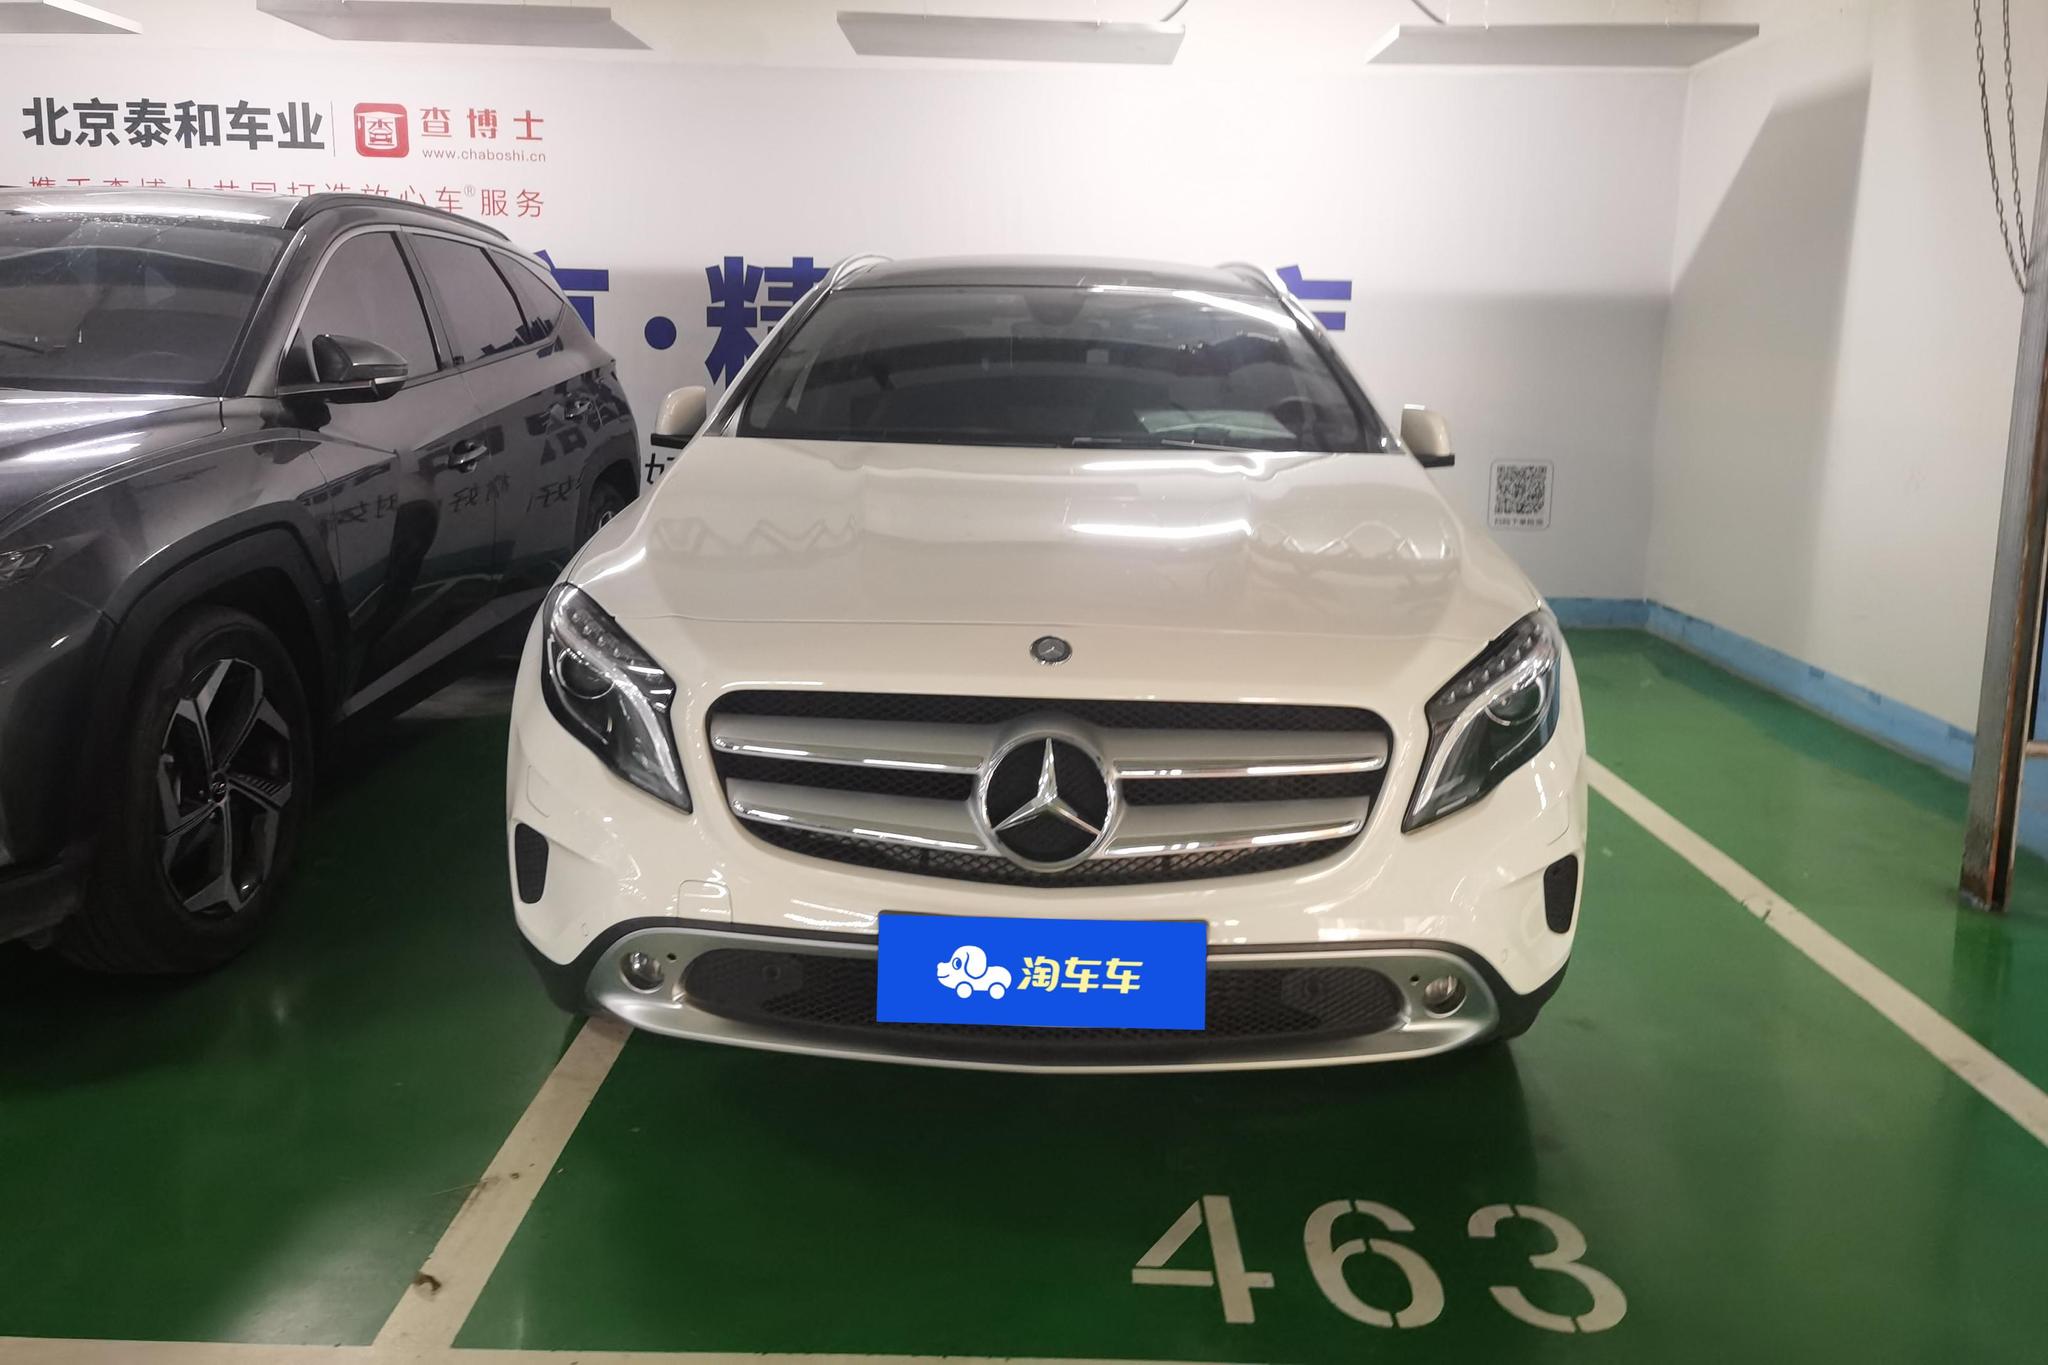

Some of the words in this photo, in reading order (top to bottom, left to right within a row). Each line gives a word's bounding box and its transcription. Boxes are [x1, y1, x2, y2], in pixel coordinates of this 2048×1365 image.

[22, 97, 325, 150] 北京泰和车业
[419, 107, 545, 141] 查博士
[422, 148, 547, 163] www.chaboshi.cn
[1132, 1195, 1628, 1333] 463
